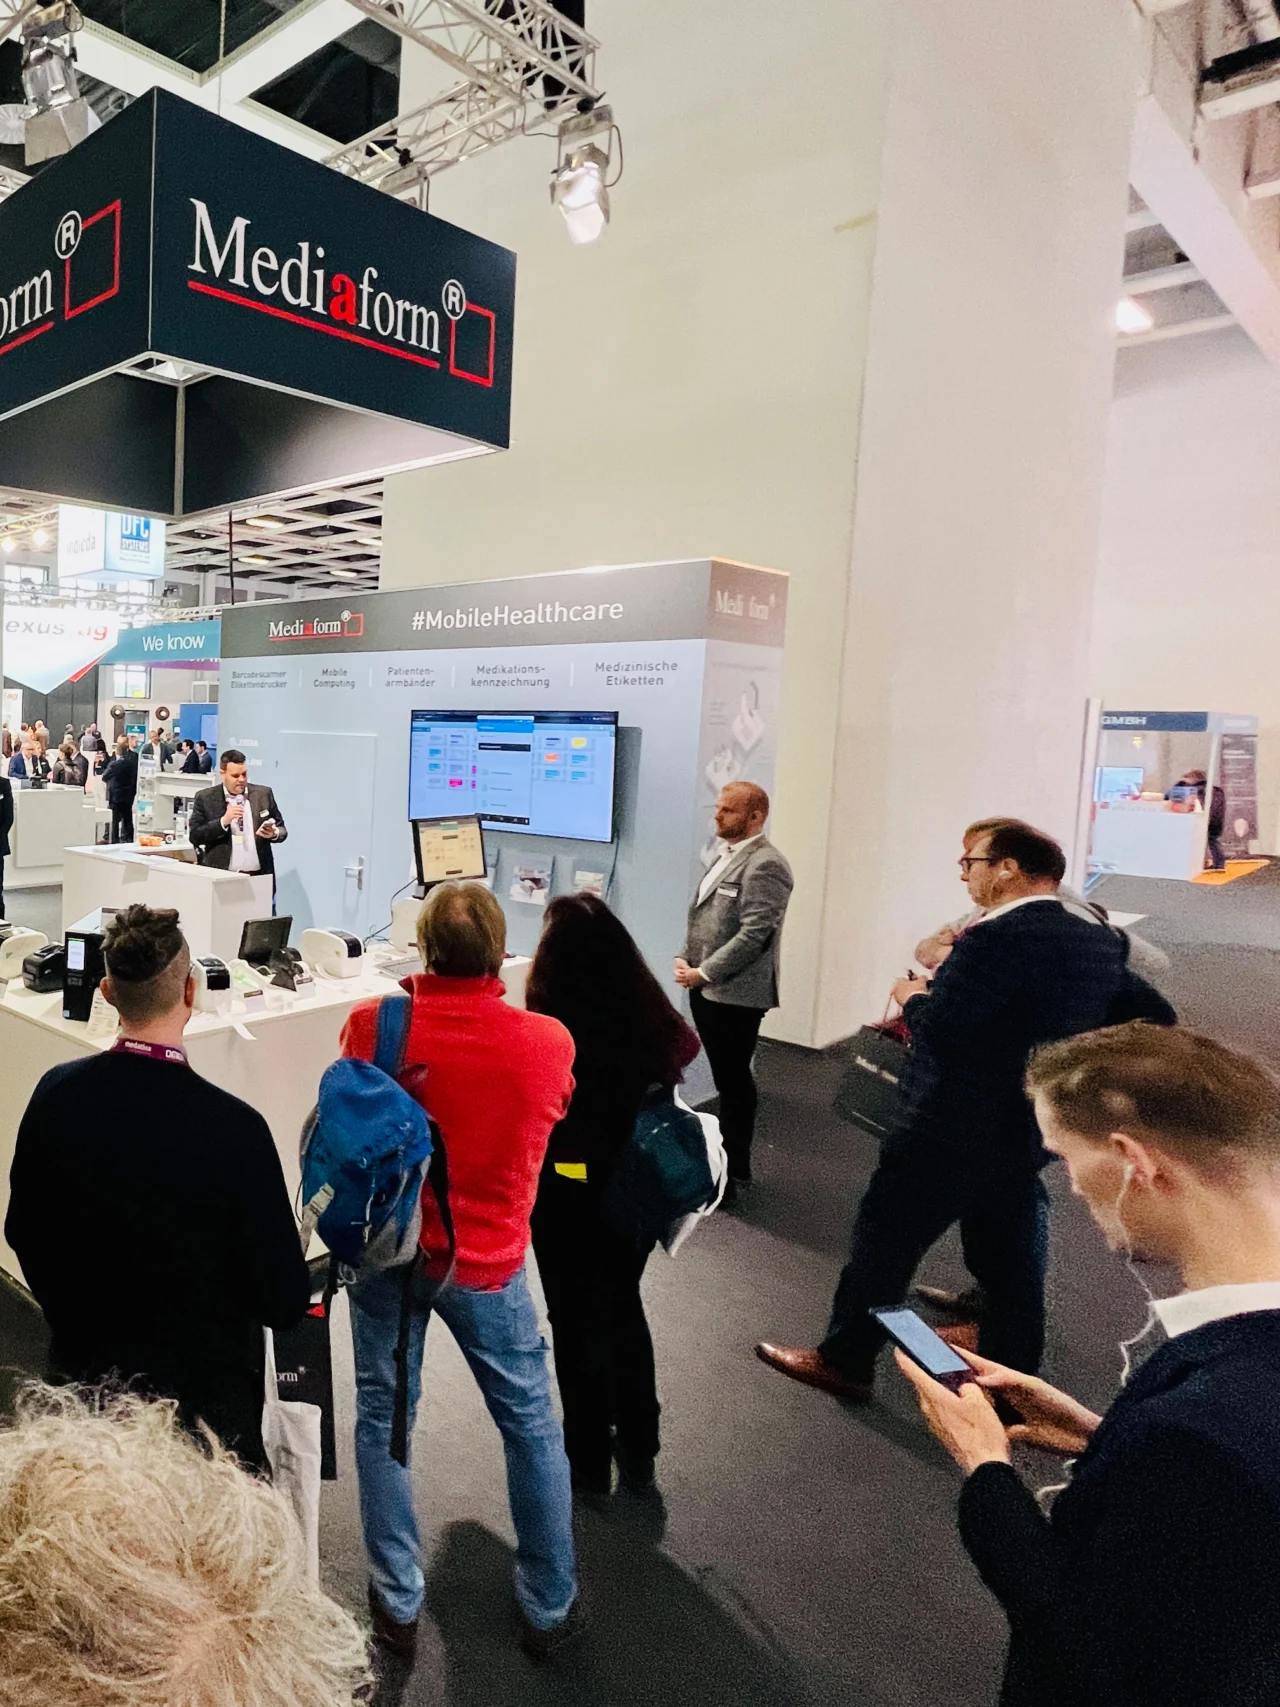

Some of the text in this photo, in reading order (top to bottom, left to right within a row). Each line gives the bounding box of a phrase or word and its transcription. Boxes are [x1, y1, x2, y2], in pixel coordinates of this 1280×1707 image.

[187, 197, 441, 354] Mediaform
[121, 539, 150, 553] SYSTEMS
[412, 601, 624, 631] #MobileHealthcare
[142, 633, 205, 652] We know
[321, 668, 348, 677] Mobile
[387, 666, 435, 677] Patienten-
[476, 665, 546, 675] Medikations-
[595, 661, 679, 673] Medizinische
[313, 679, 356, 690] Computing
[385, 677, 436, 688] armbänder
[471, 677, 550, 689] kennzeichnung
[605, 675, 664, 686] Etiketten
